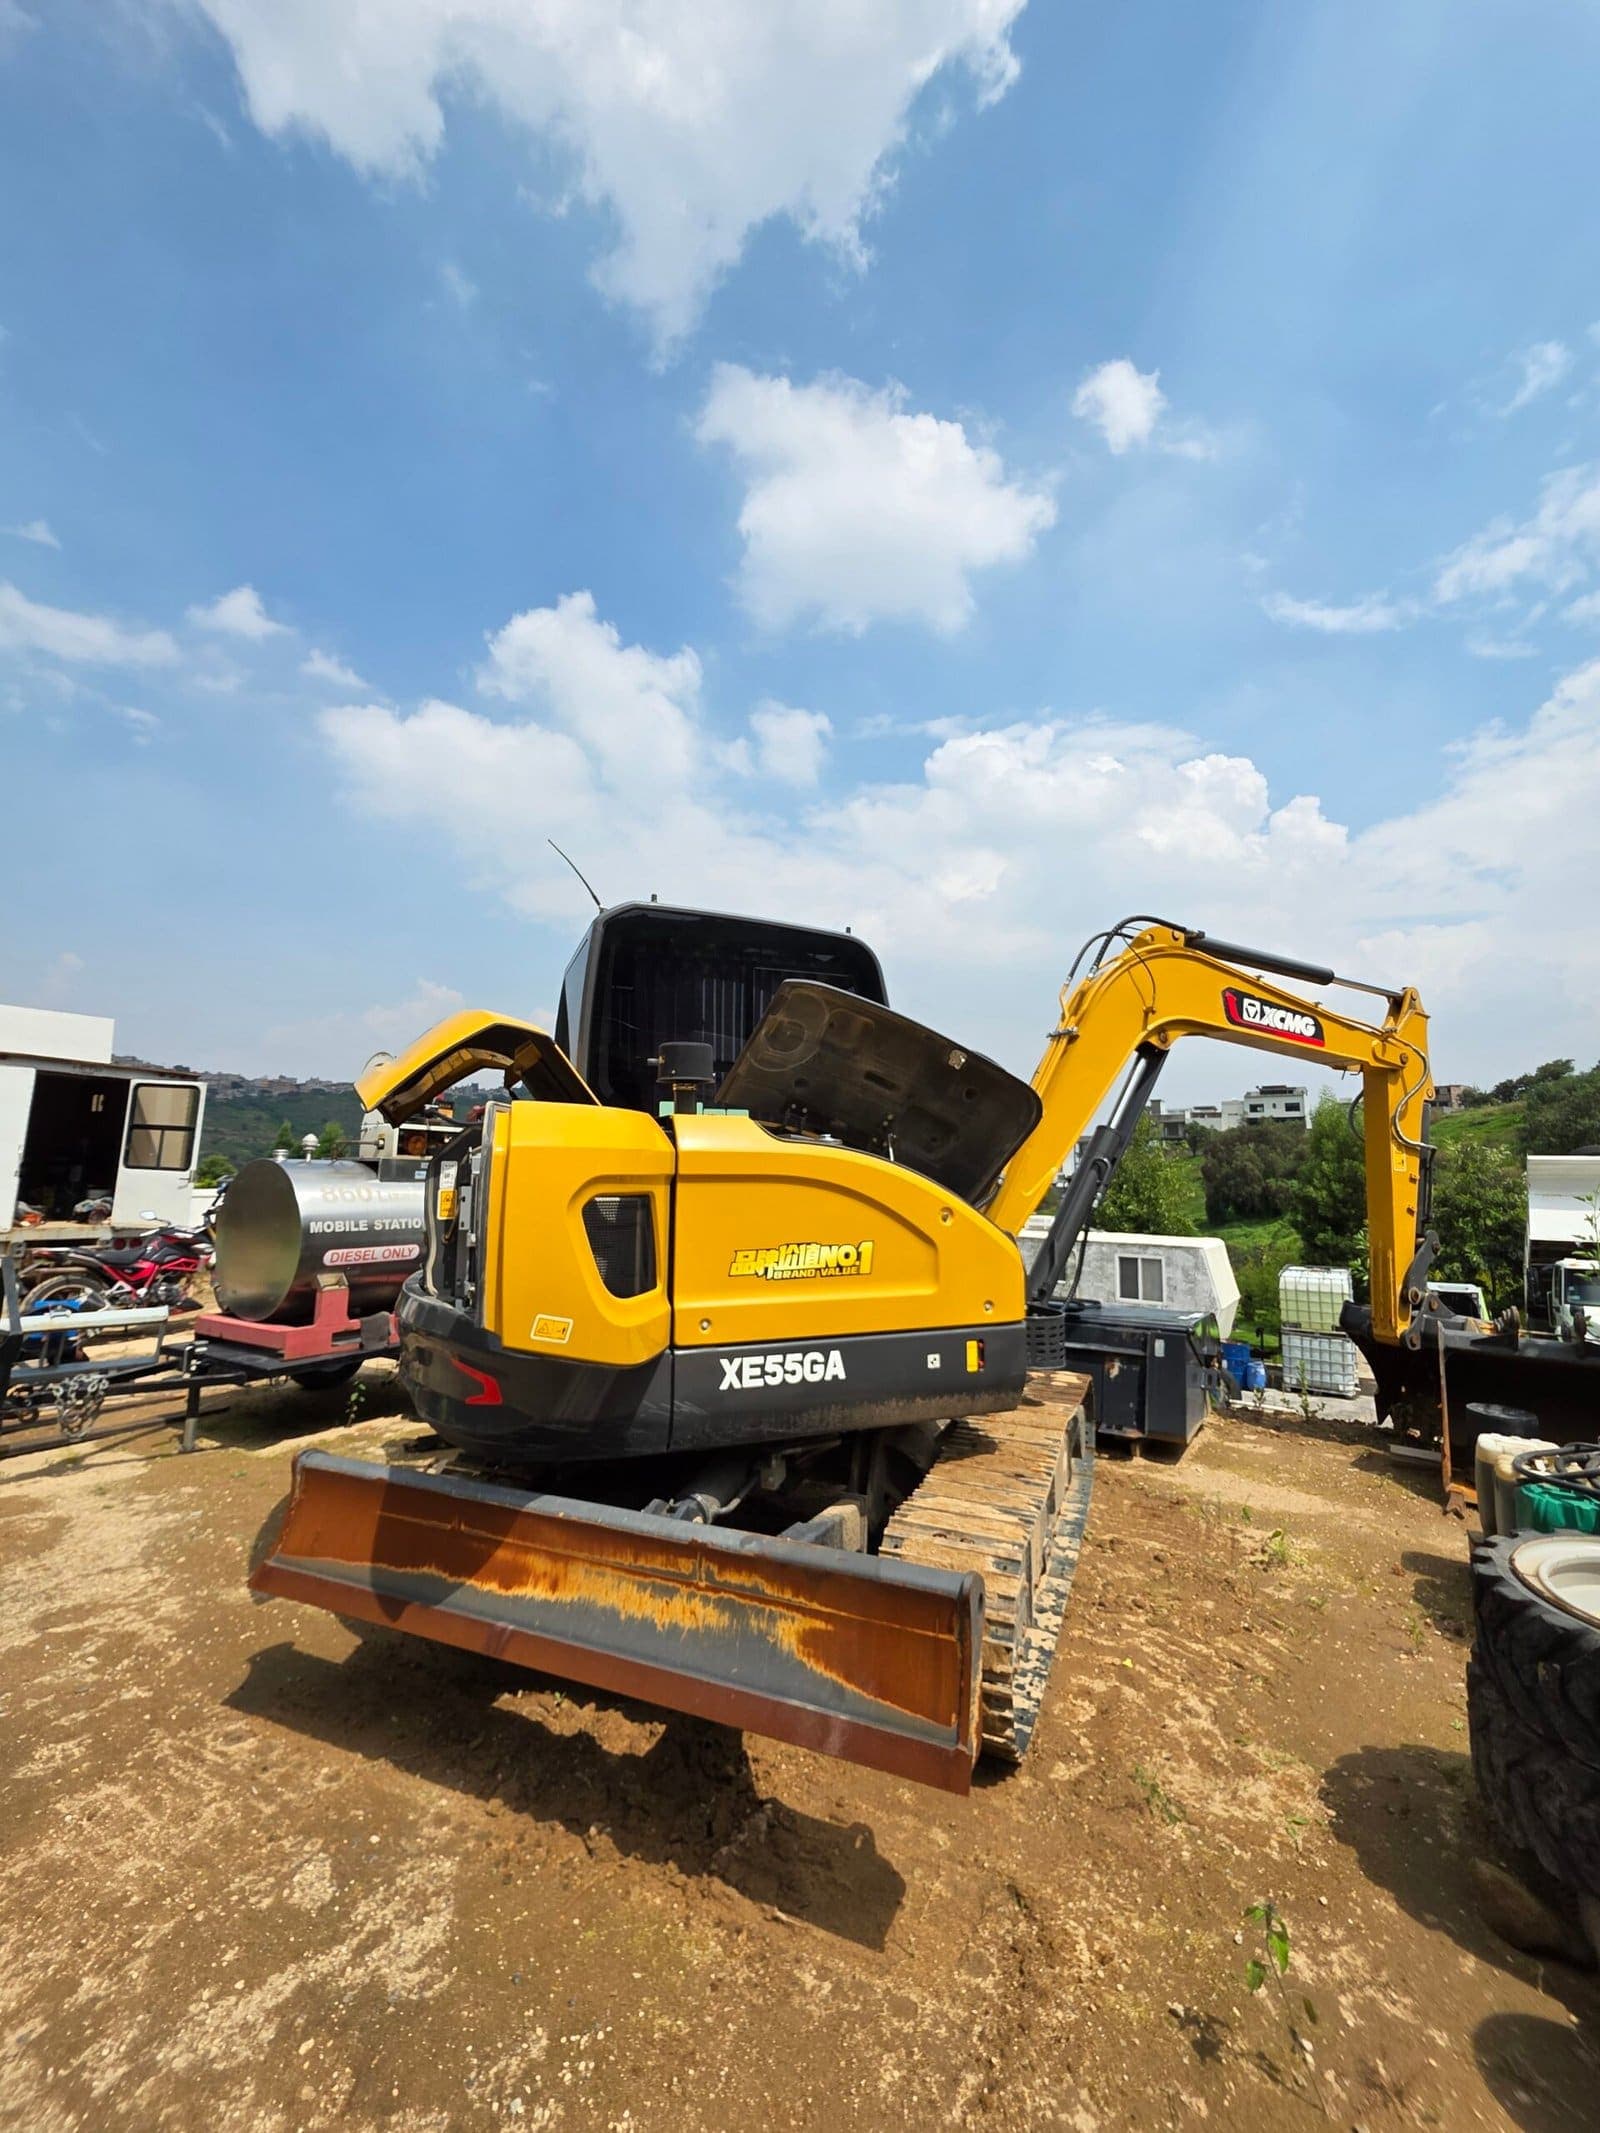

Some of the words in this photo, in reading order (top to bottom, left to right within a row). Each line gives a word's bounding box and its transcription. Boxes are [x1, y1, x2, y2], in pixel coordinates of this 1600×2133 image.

[1261, 1004, 1316, 1037] XCMG
[309, 1220, 368, 1233] MOBILE
[330, 1249, 377, 1263] DIESEL
[382, 1247, 414, 1259] ONLY
[774, 1268, 815, 1279] BRAND
[821, 1266, 859, 1276] VALUE
[719, 1350, 847, 1390] XE55GA
